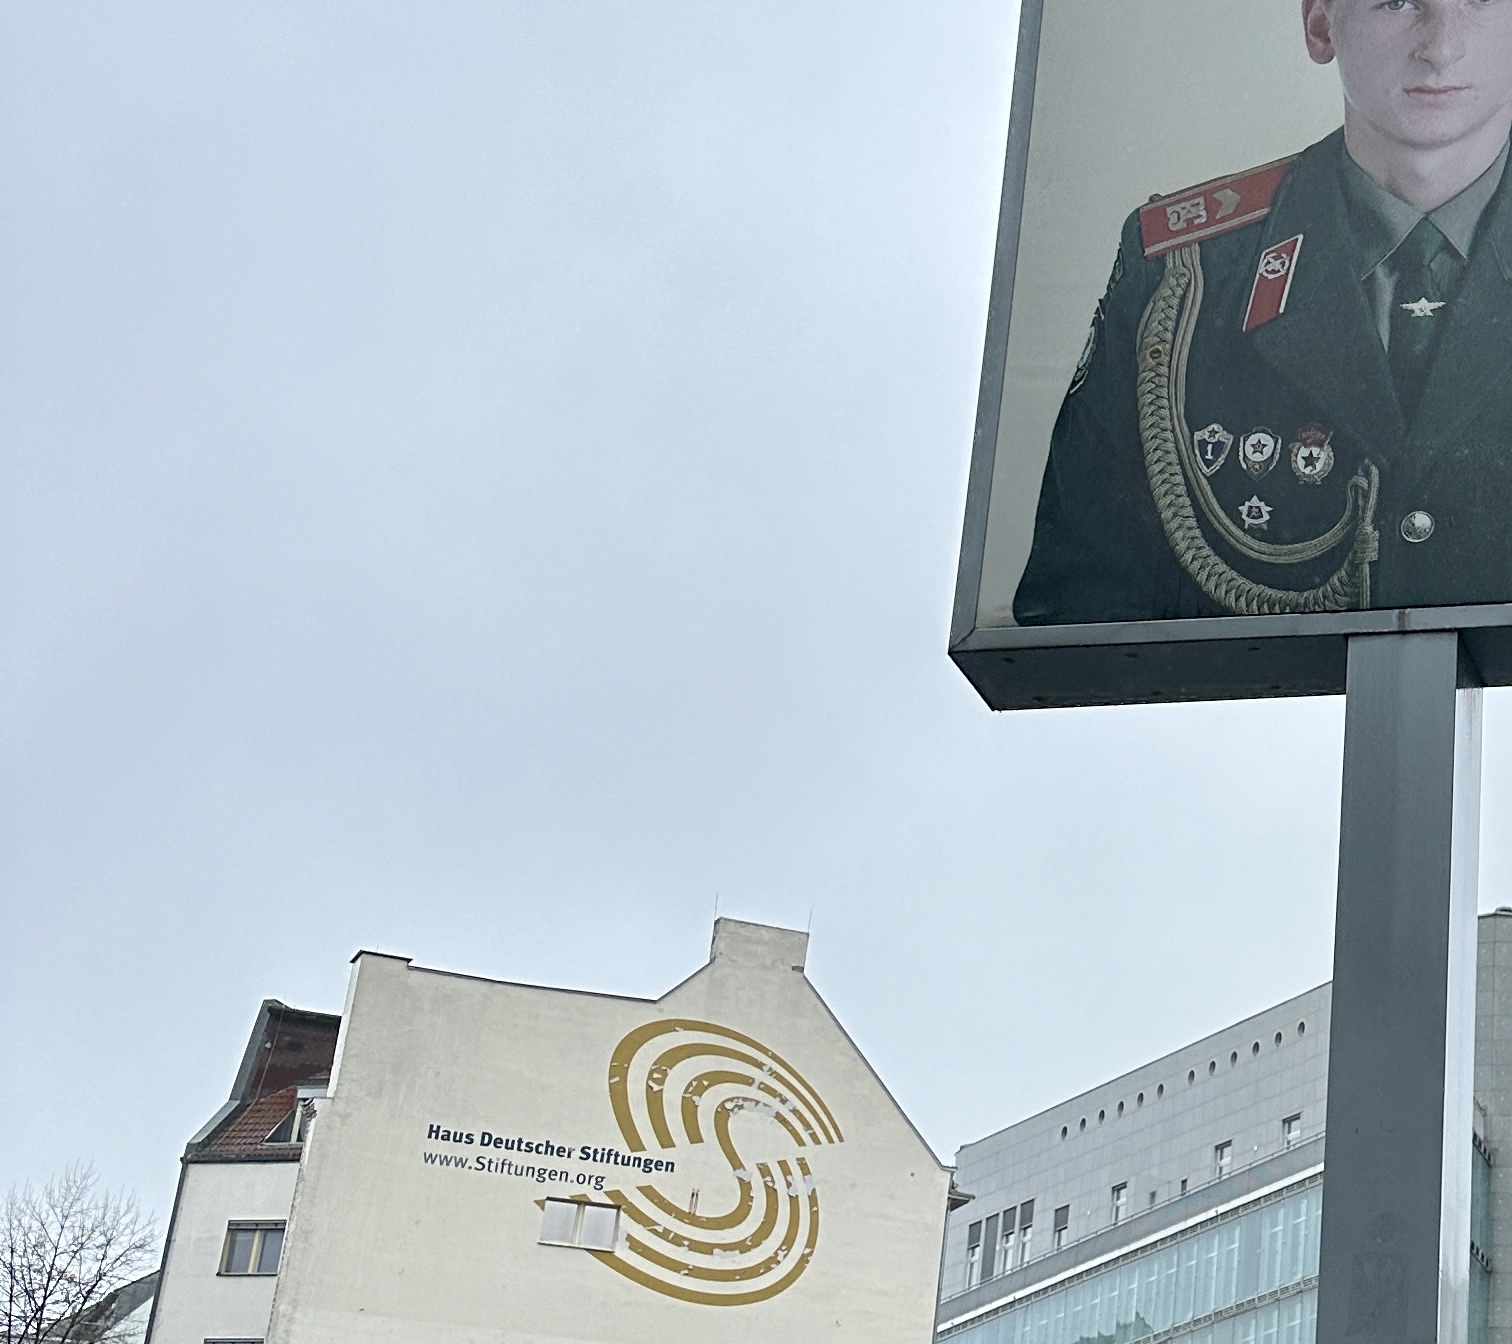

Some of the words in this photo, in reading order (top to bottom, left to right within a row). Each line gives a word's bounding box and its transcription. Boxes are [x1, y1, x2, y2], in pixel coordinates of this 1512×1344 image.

[423, 1151, 606, 1190] www.Stiftungen.org
[427, 1124, 475, 1145] Haus
[479, 1131, 576, 1159] Deutscher
[579, 1146, 676, 1173] Stiftungen
